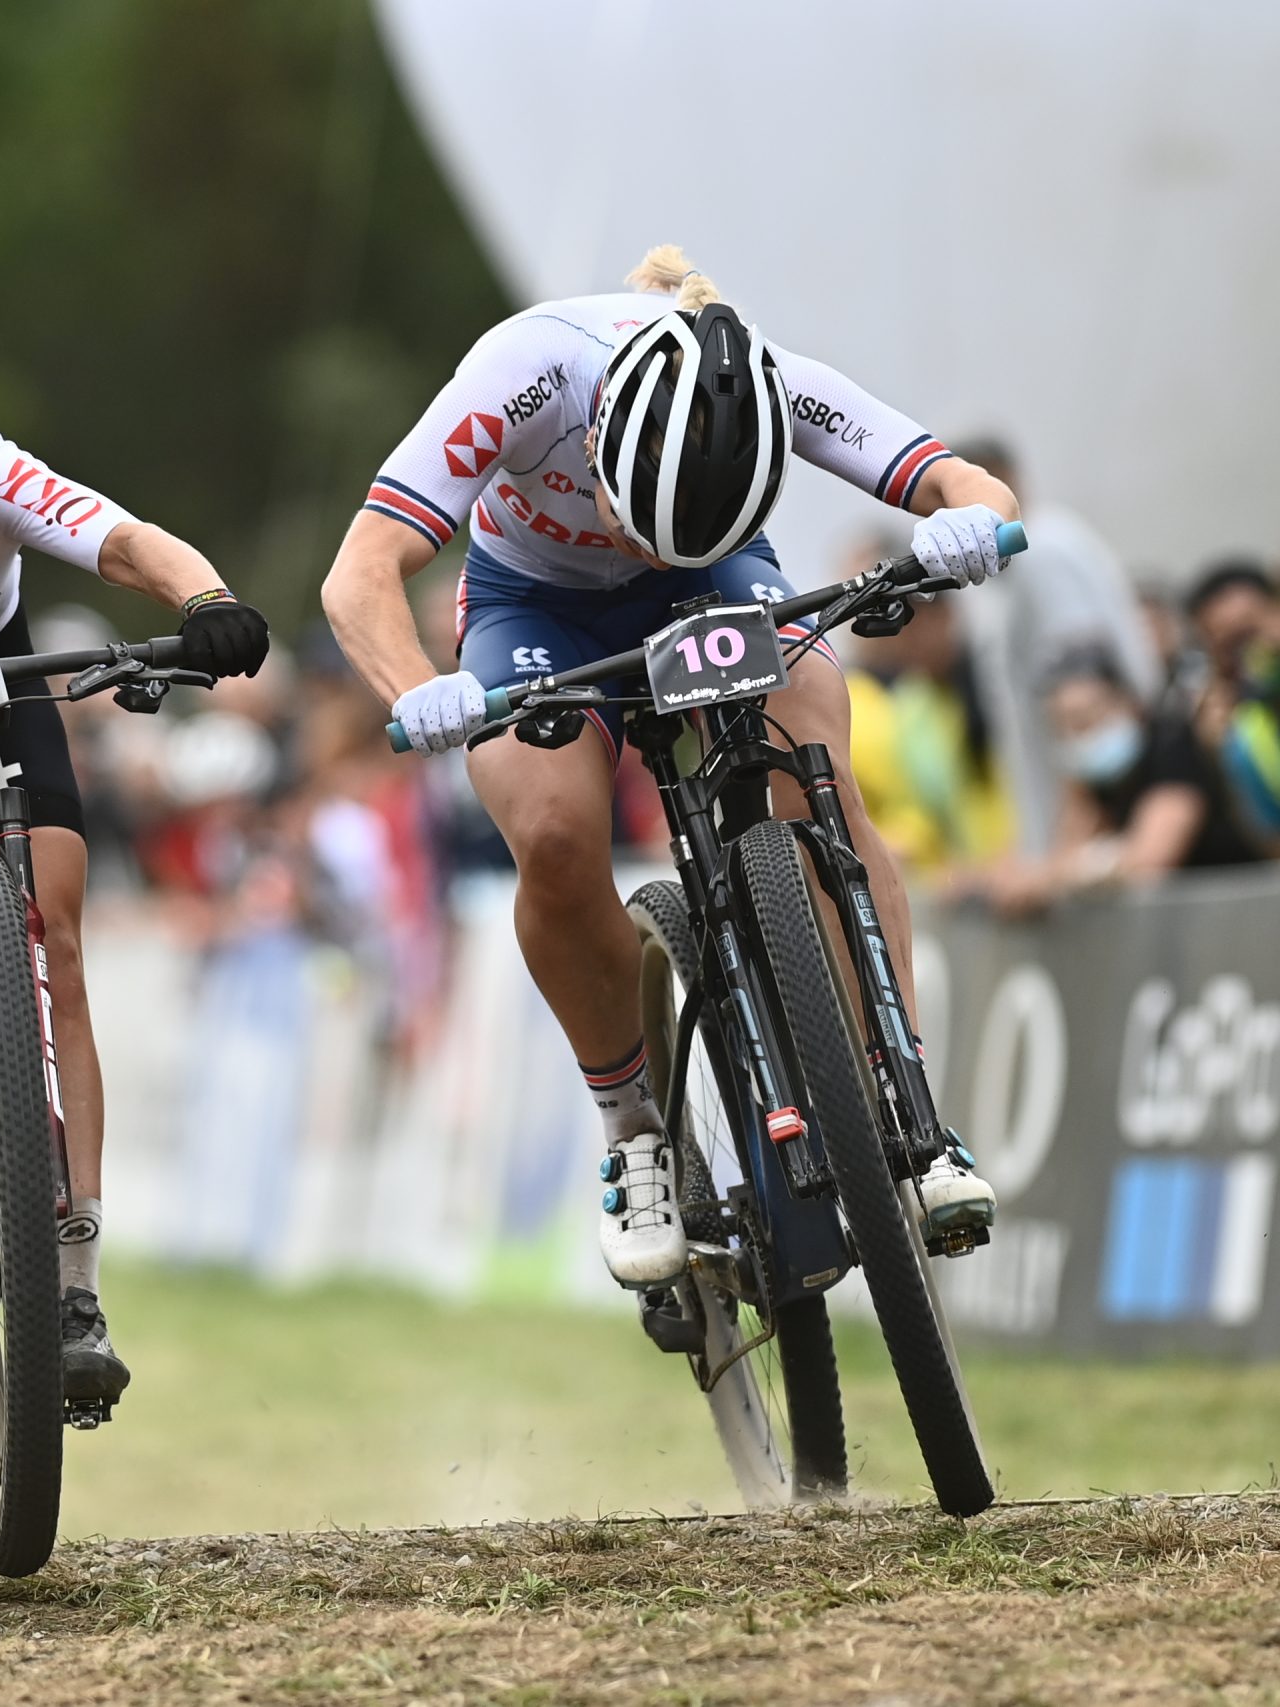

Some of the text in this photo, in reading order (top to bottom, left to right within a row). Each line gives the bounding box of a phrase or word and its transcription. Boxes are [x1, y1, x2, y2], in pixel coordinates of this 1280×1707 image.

[503, 376, 553, 427] HSBC
[546, 363, 570, 393] UK
[841, 420, 875, 452] UK
[675, 627, 746, 673] 10
[878, 1006, 894, 1042] ULTIMATE
